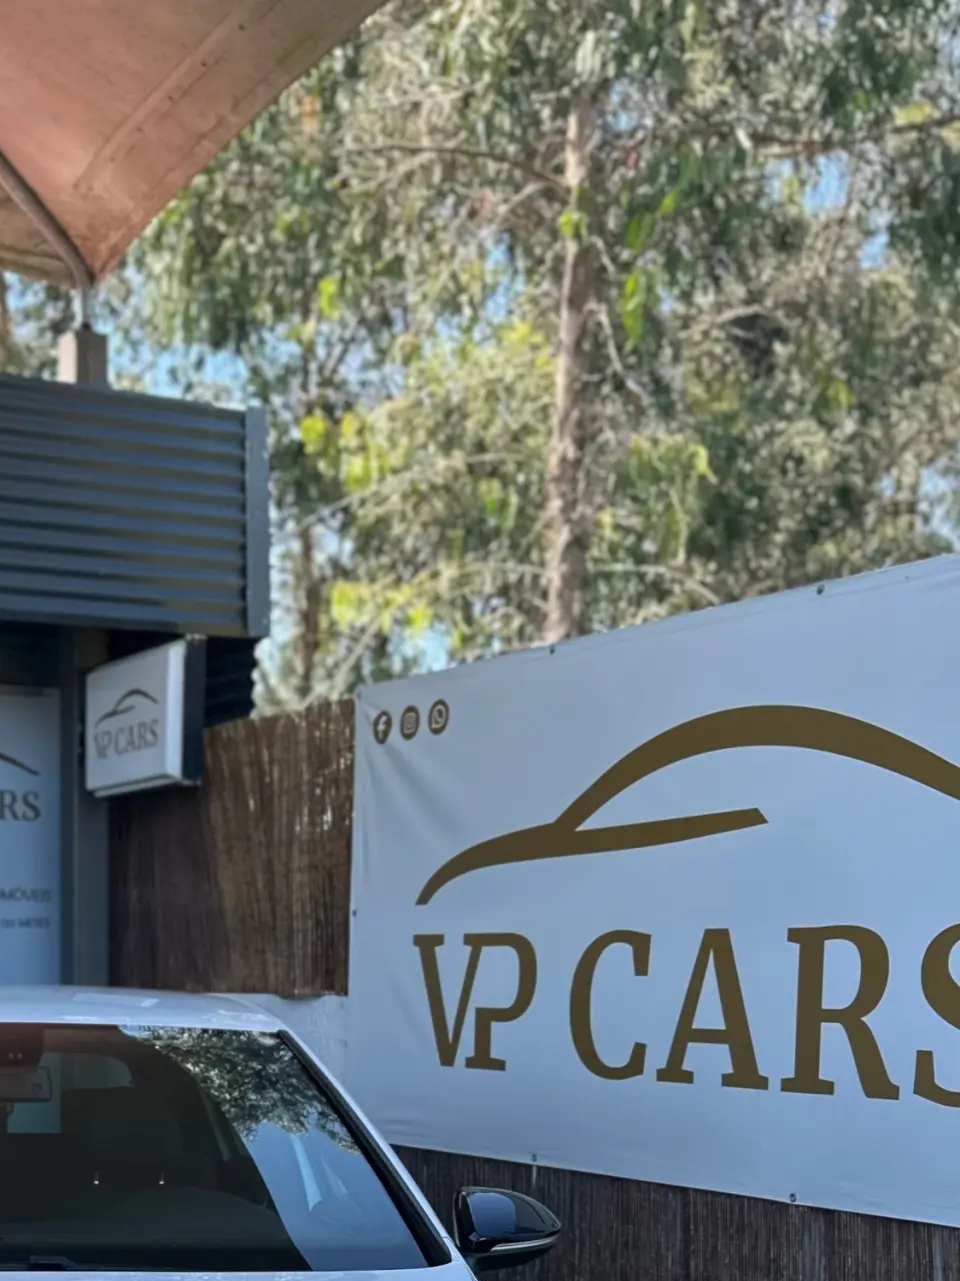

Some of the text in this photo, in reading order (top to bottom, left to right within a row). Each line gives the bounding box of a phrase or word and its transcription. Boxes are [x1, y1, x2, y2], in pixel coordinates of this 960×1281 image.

[93, 719, 159, 759] VP CARS
[413, 932, 538, 1071] VP
